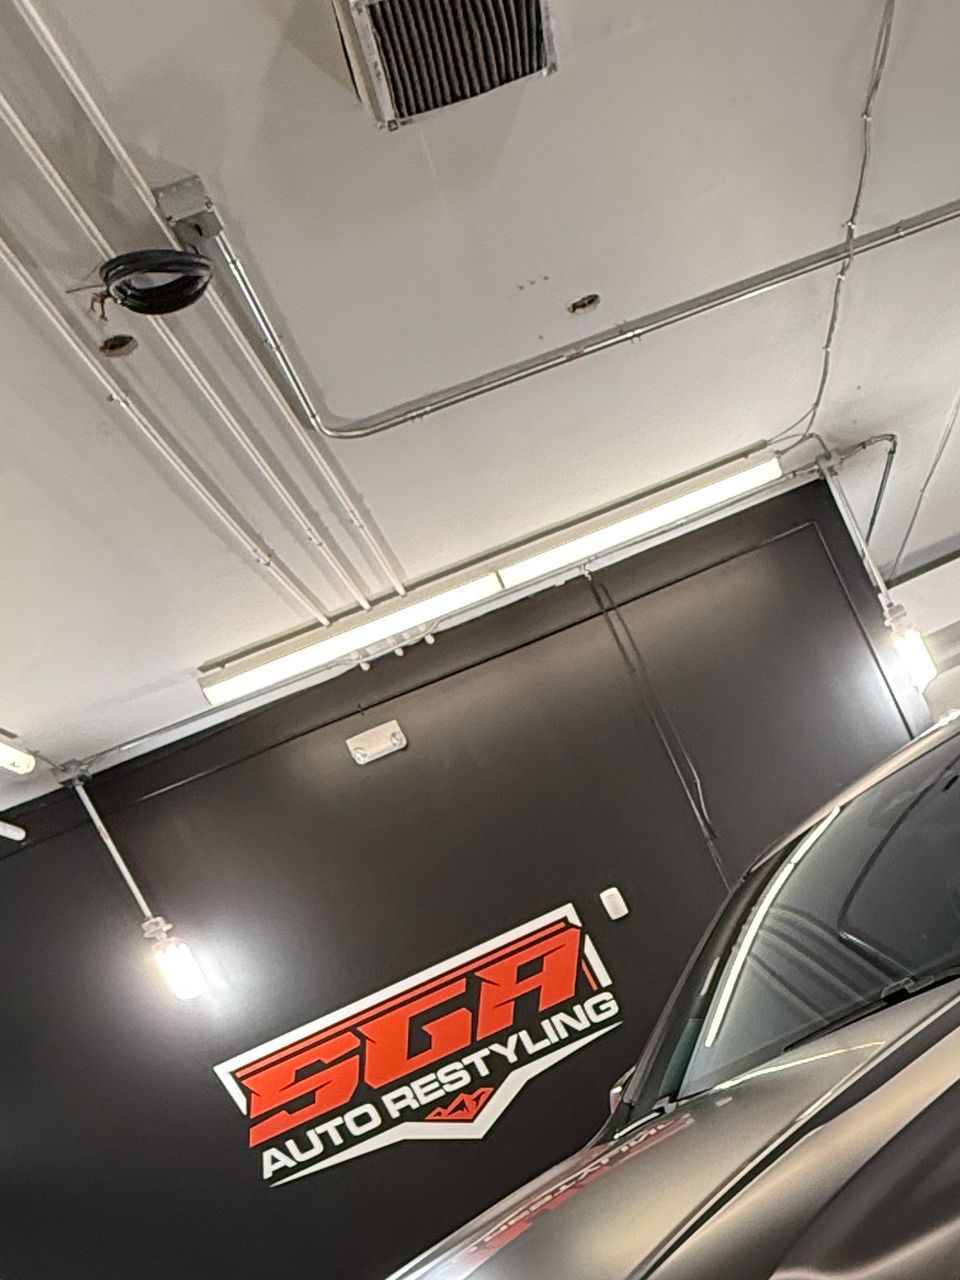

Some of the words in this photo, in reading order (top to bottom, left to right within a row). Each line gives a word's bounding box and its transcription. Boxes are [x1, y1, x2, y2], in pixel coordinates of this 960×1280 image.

[240, 925, 582, 1148] SGA
[261, 1103, 382, 1180] AUTO
[380, 991, 619, 1119] RESTYLING
